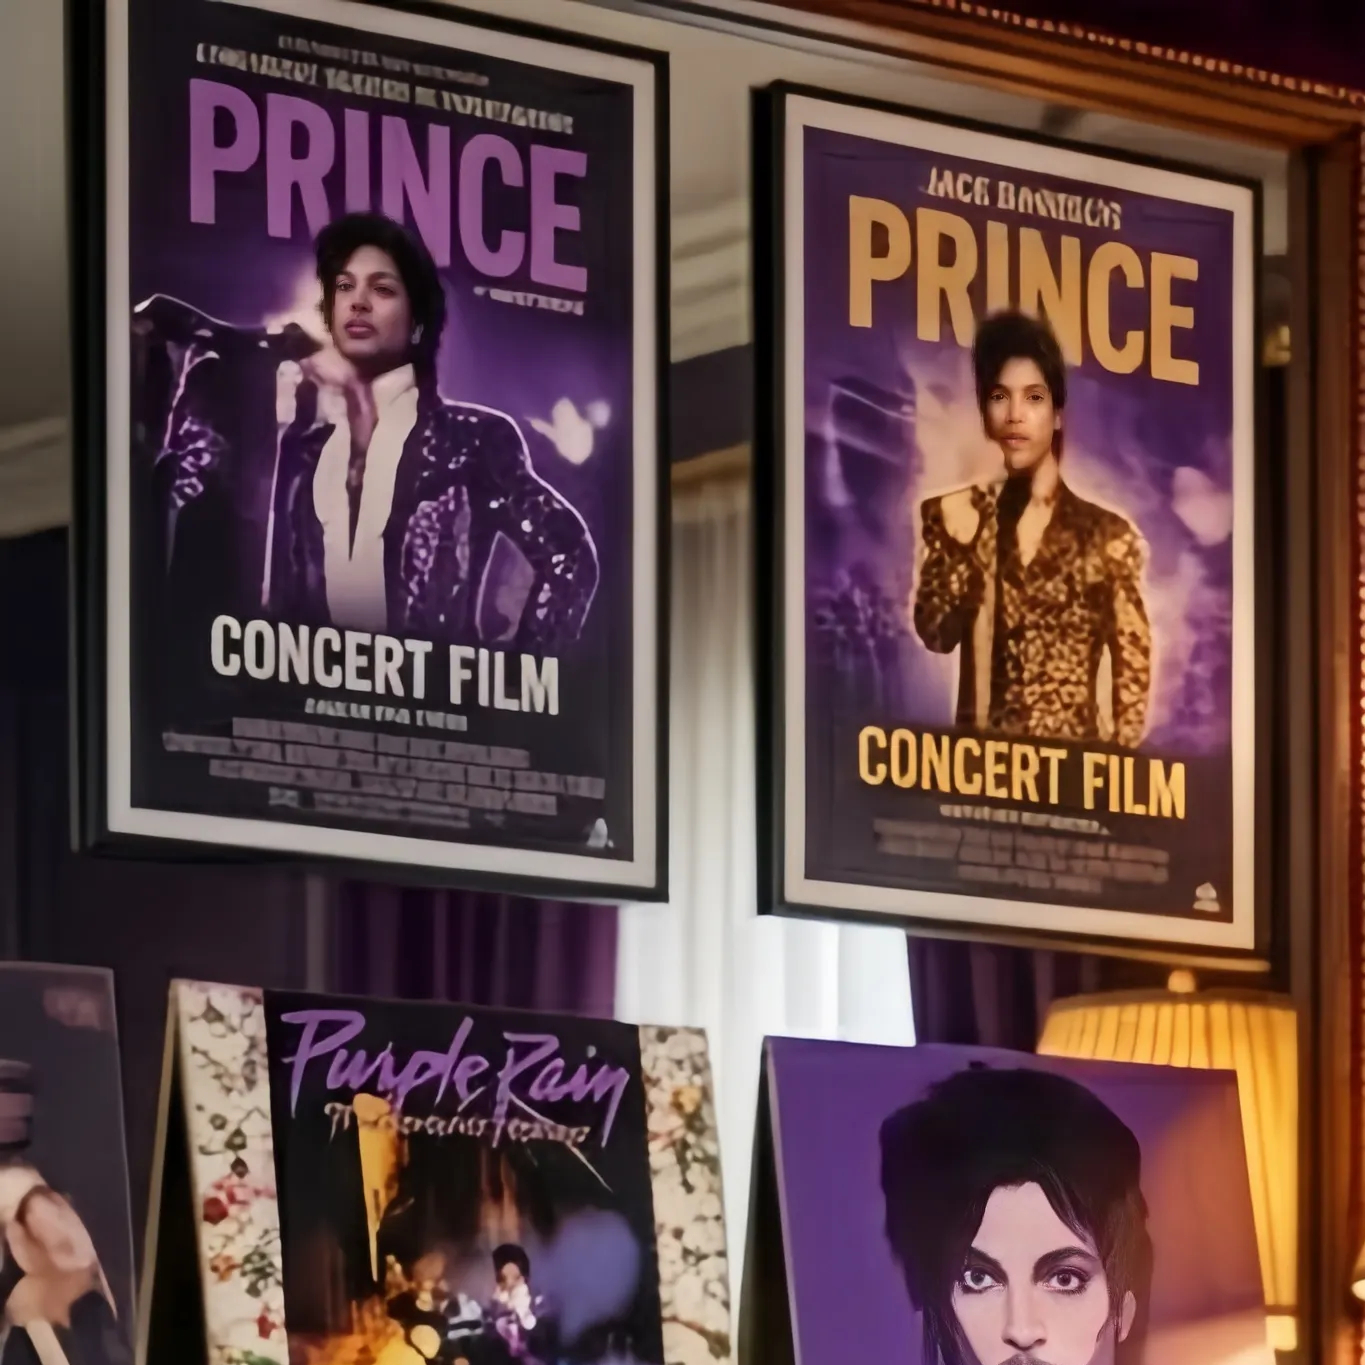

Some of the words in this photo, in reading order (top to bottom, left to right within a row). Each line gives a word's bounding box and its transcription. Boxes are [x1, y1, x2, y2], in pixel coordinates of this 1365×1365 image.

[190, 78, 587, 292] PRINCE
[849, 194, 1199, 386] PRINCE
[210, 614, 433, 700] CONCERT
[449, 644, 559, 715] FILM
[858, 725, 1067, 804] CONCERT
[1083, 752, 1185, 819] FILM
[281, 1009, 489, 1119] Purple
[492, 1032, 629, 1191] Rain
